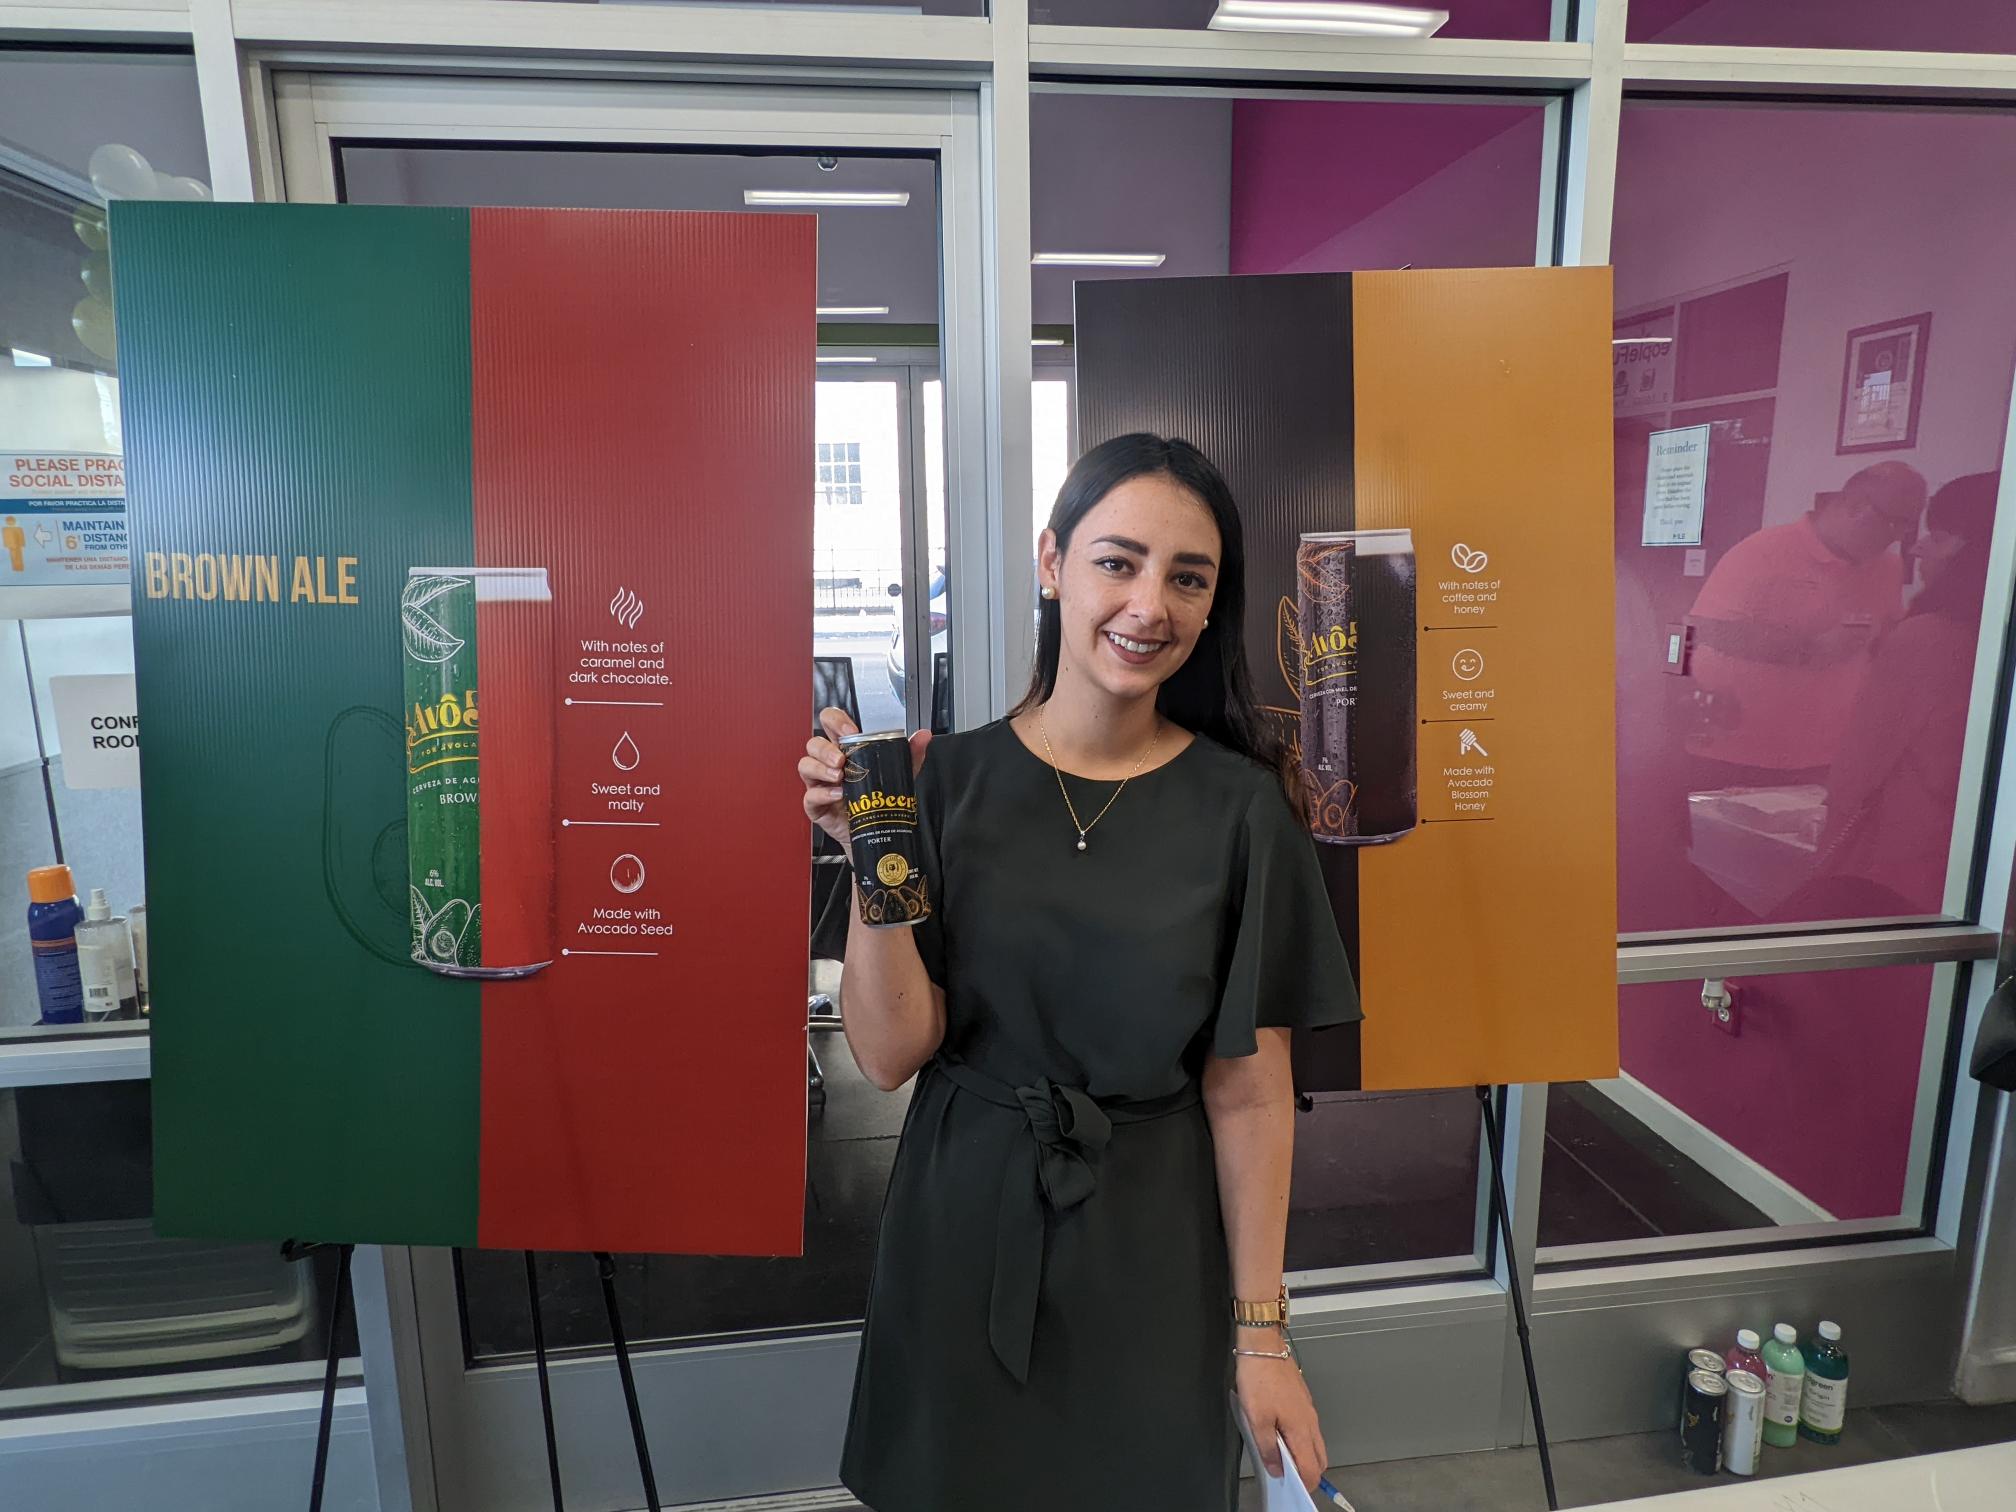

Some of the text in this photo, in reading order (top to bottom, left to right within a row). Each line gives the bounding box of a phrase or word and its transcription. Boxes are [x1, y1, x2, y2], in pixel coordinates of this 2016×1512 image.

[1656, 440, 1698, 456] Reminder
[15, 459, 79, 471] PLEASE
[9, 475, 73, 487] SOCIAL
[62, 520, 125, 531] MAINTAIN
[144, 552, 359, 604] BROWN ALE
[1438, 580, 1500, 590] With notes of
[1442, 592, 1496, 602] coffee and
[1454, 605, 1485, 615] honey
[581, 639, 664, 653] With notes of
[580, 657, 664, 669] caramel and
[569, 671, 672, 685] dark chocolate.
[1442, 689, 1495, 700] Sweet and
[1450, 702, 1487, 712] creamy
[1443, 766, 1495, 776] Made with
[412, 779, 441, 794] CERVEZA
[445, 777, 457, 785] DE
[1448, 778, 1493, 788] Avocado
[591, 783, 660, 795] Sweet and
[1451, 790, 1489, 799] Blossom
[608, 799, 644, 812] malty
[1454, 802, 1486, 811] Honey
[867, 836, 892, 845] PORTER
[593, 908, 660, 919] Made with
[577, 922, 673, 935] Avocado Seed
